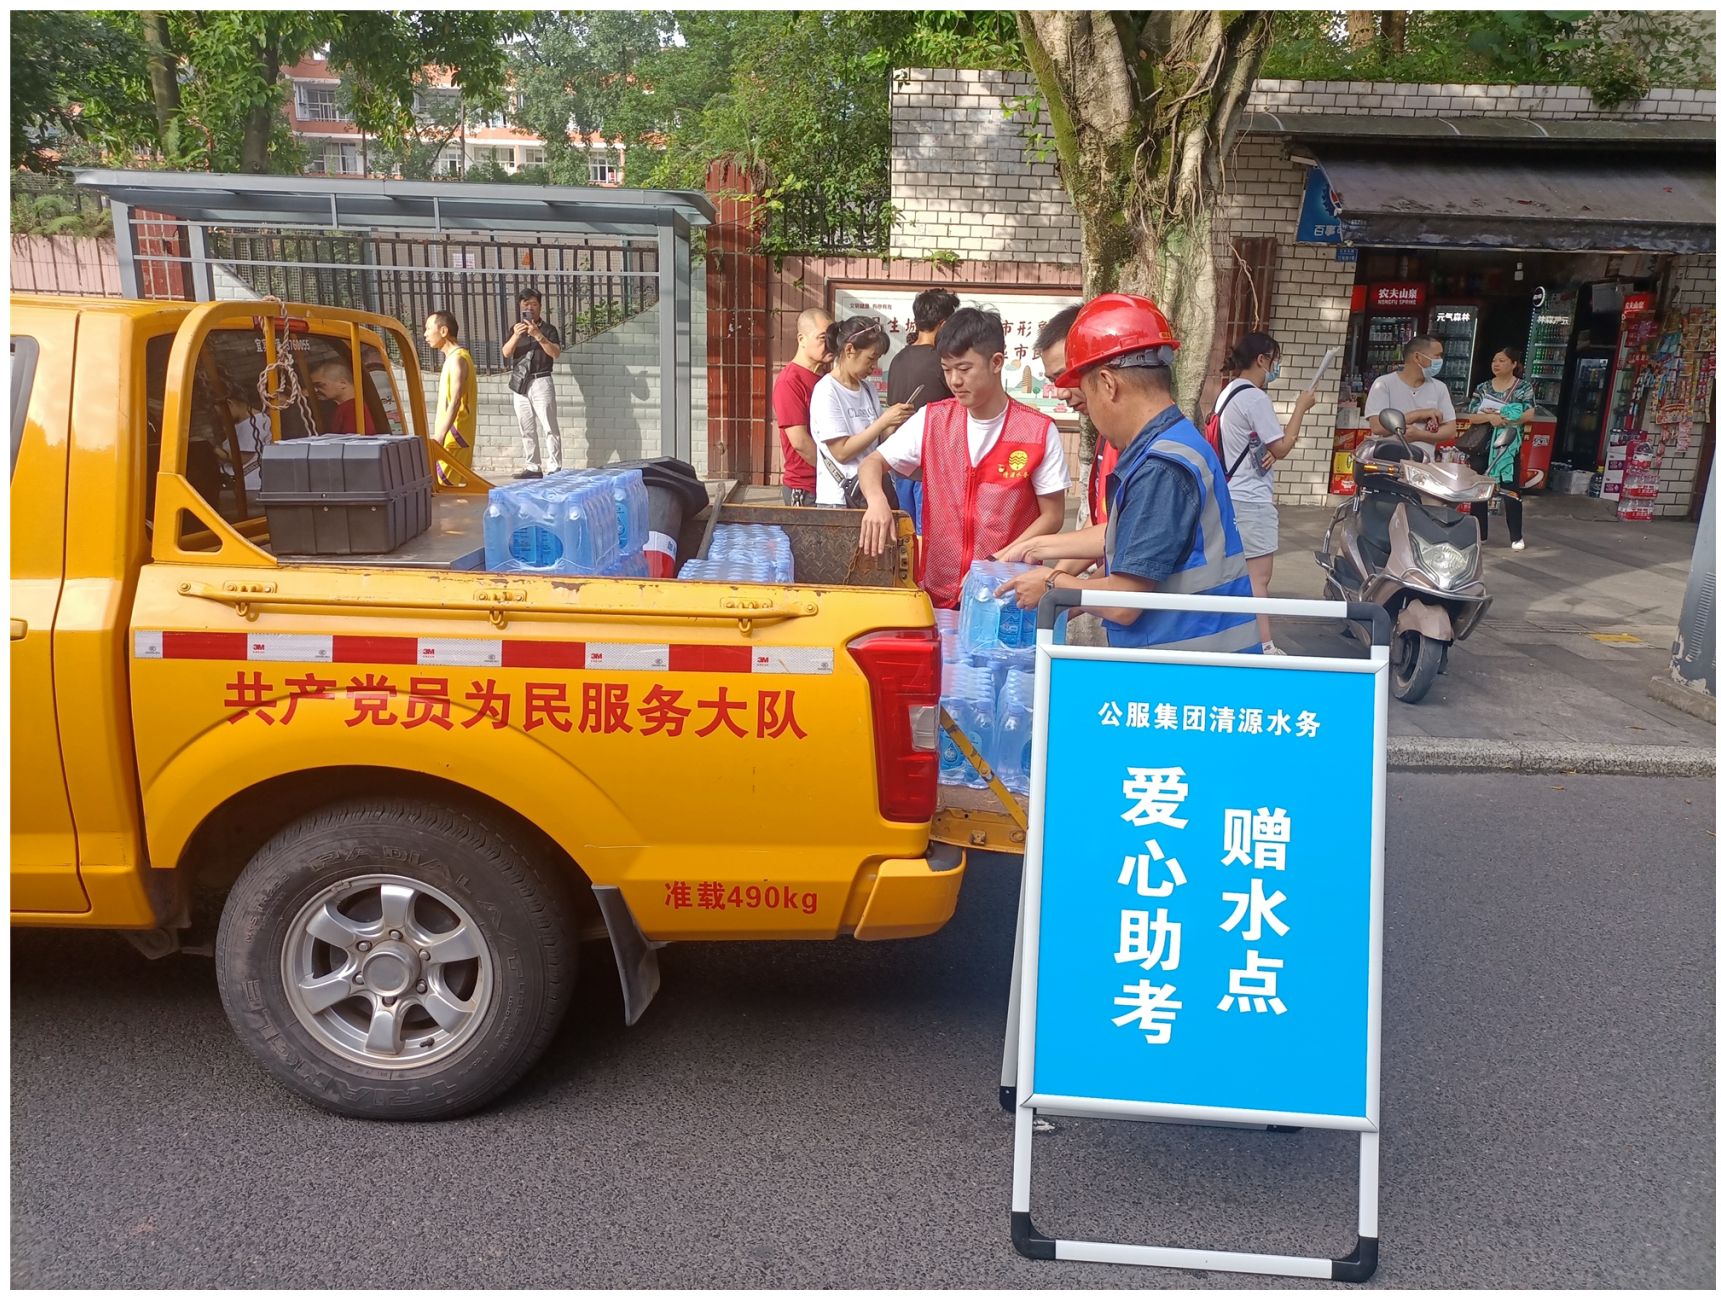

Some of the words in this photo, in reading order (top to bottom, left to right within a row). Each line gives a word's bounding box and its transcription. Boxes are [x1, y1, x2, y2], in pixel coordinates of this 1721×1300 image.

[1378, 287, 1418, 299] 农夫山泉
[1436, 312, 1470, 322] 元气森林
[224, 671, 808, 740] 共产党员为民服务大队
[1097, 700, 1321, 738] 公服集团清源水务
[664, 880, 818, 915] 准载490kg
[1110, 766, 1190, 1045] 爱心助考
[1216, 806, 1292, 1016] 赠水点
